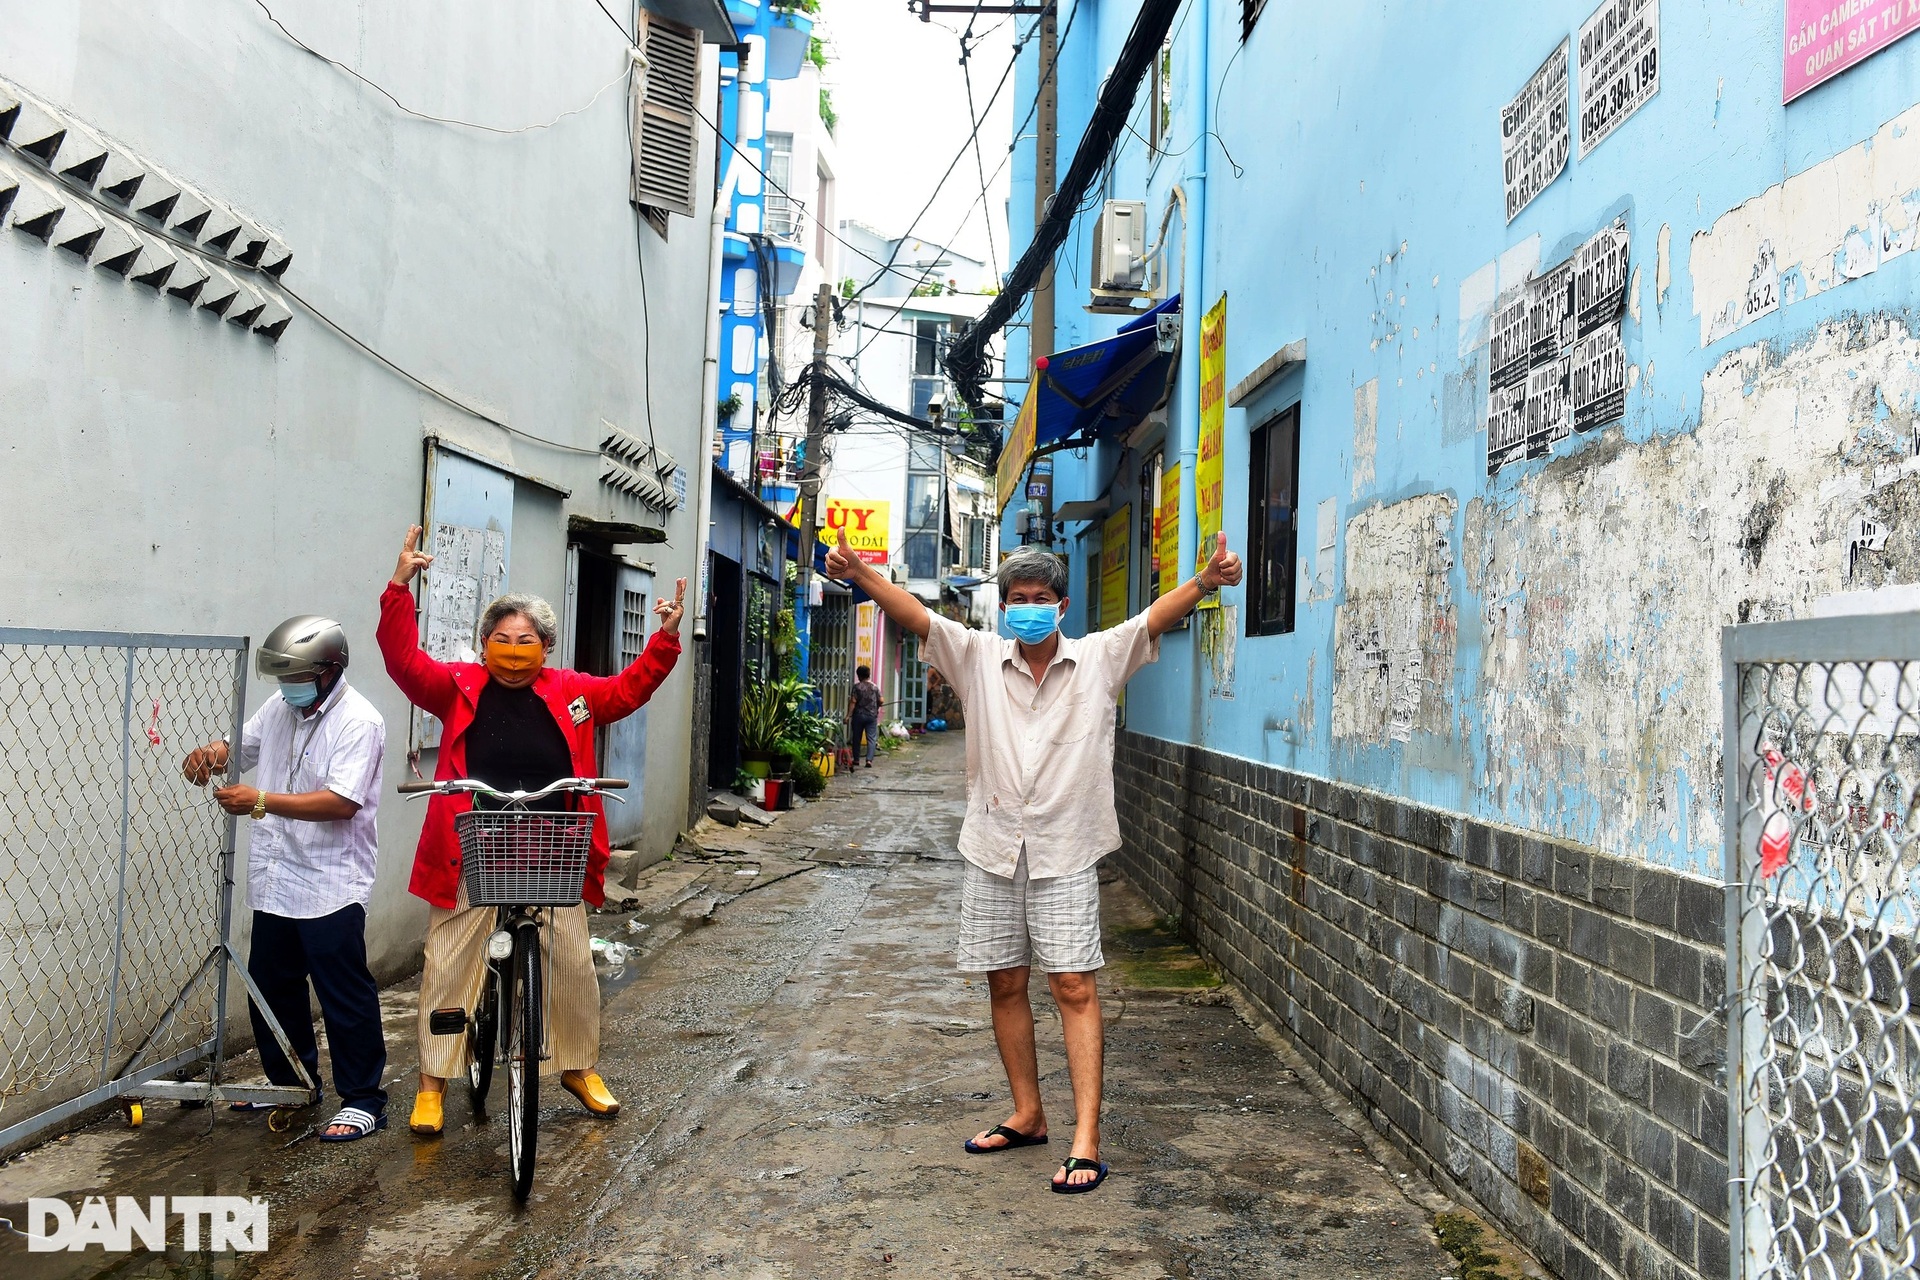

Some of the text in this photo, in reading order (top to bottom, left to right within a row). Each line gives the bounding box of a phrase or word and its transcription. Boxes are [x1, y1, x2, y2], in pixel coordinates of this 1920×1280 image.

[1580, 30, 1592, 68] CHO
[1593, 17, 1604, 55] VAY
[1789, 0, 1876, 55] GẮN CAMER
[1805, 37, 1844, 76] QUAN
[1847, 18, 1877, 51] SÁT
[1581, 47, 1656, 142] 0932.384.199
[1609, 60, 1618, 79] SAU
[1505, 97, 1567, 185] 0776.950.950
[1574, 347, 1624, 410] 0901.52.23.23
[827, 501, 875, 530] ÙY
